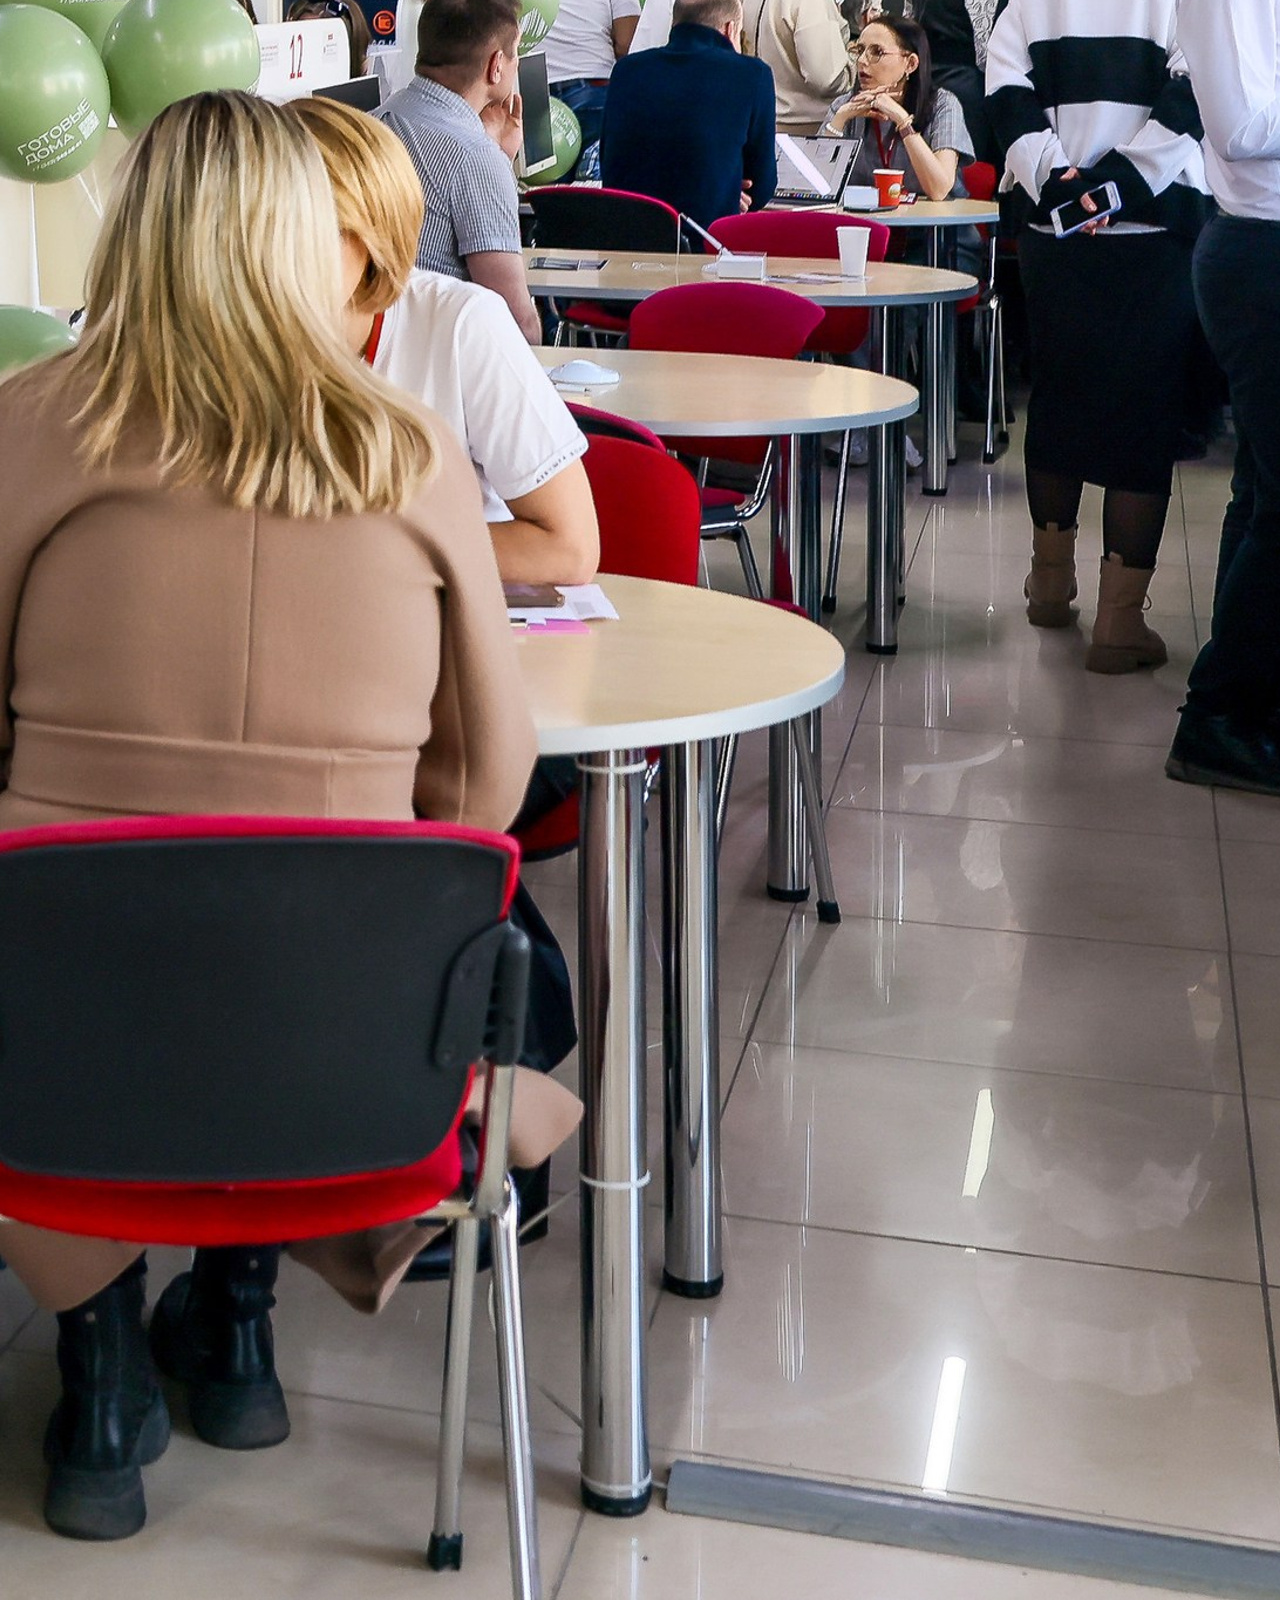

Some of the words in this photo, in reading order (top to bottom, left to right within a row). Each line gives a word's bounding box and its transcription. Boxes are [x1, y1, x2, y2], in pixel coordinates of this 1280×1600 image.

[289, 33, 305, 80] 12
[17, 97, 91, 156] ГОТОВЫЕ
[25, 133, 75, 166] ДОМА
